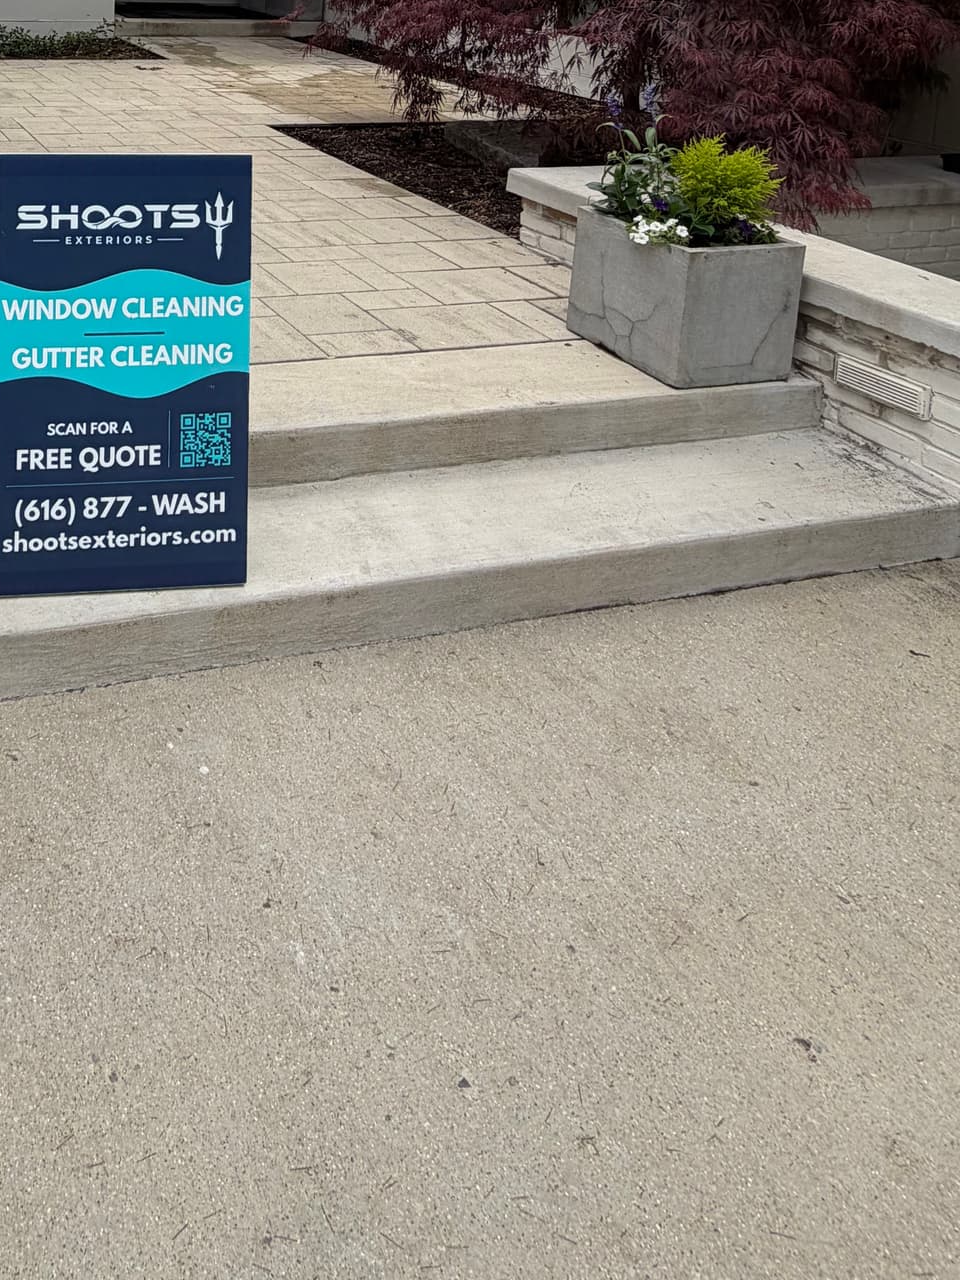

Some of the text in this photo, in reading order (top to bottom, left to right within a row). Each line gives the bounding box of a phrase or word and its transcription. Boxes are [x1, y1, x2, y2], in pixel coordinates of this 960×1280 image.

[16, 204, 200, 230] SHOOTS
[65, 235, 153, 245] EXTERIORS
[1, 295, 244, 321] WINDOW CLEANING
[11, 343, 233, 369] GUTTER CLEANING
[47, 421, 133, 436] SCAN FOR A
[15, 445, 161, 472] FREE QUOTE
[14, 497, 76, 527] (616)
[83, 495, 133, 518] 877
[151, 491, 226, 516] WASH
[2, 527, 237, 553] shootsexteriors.com
